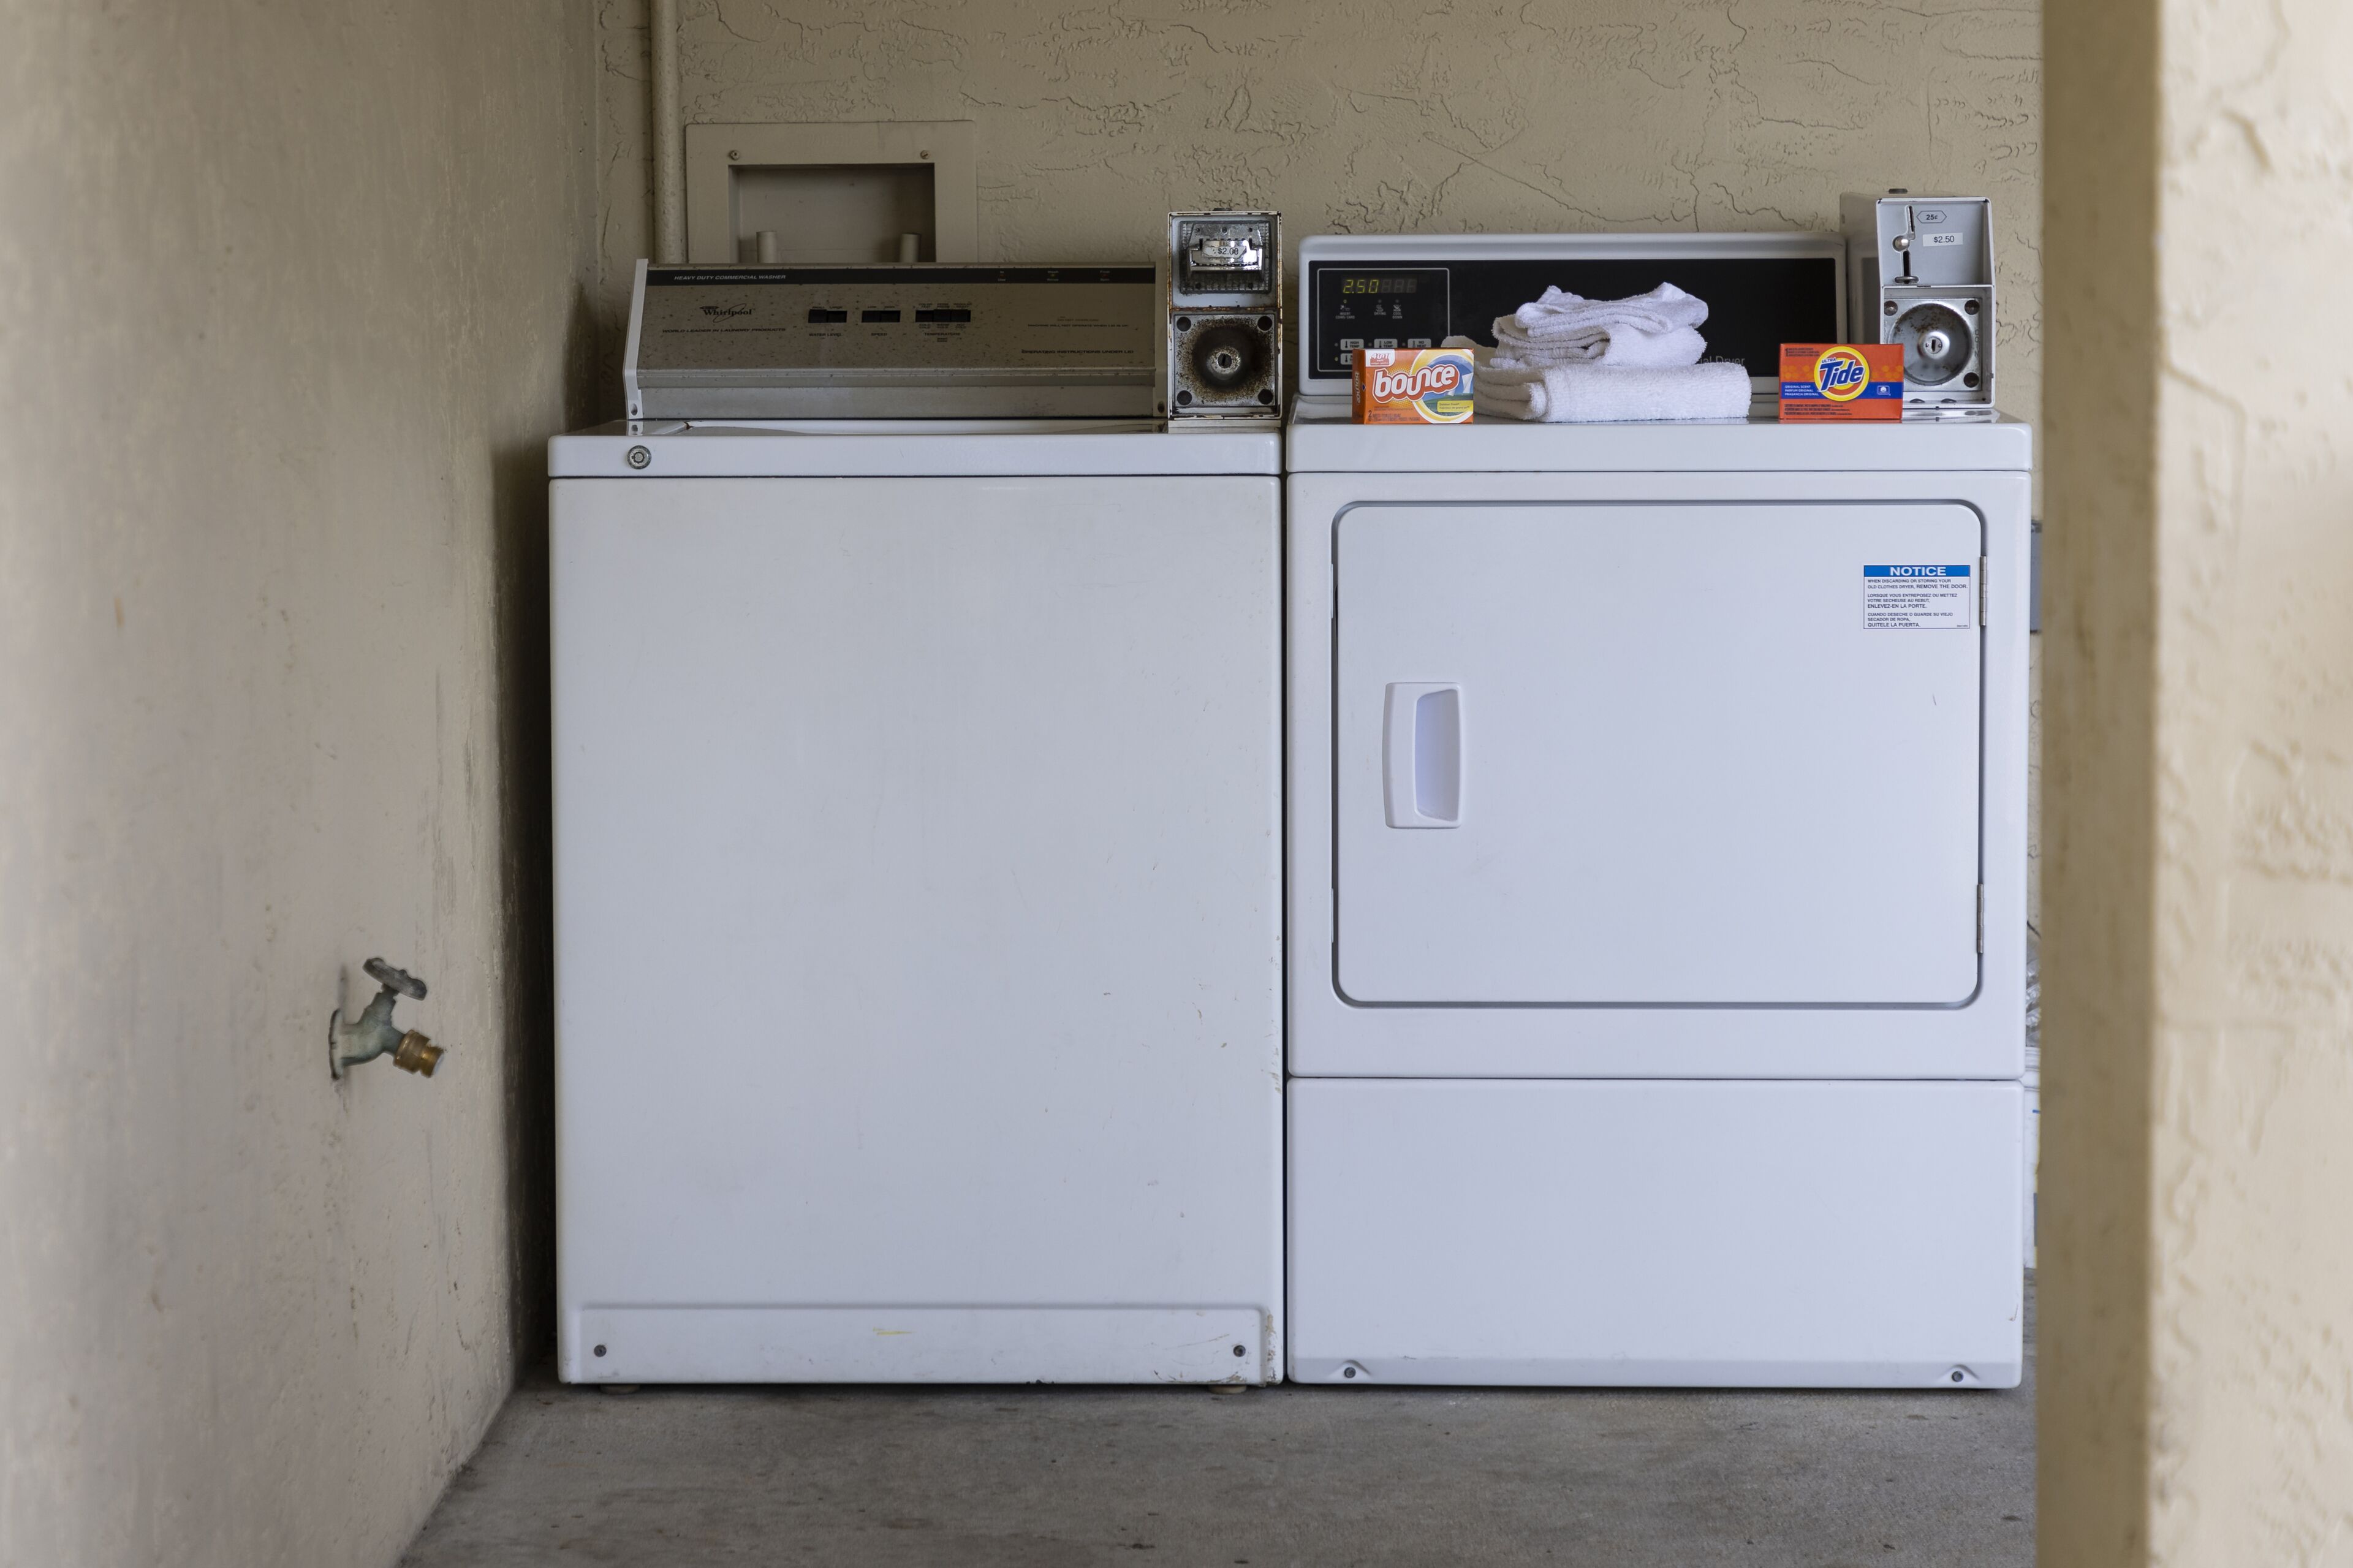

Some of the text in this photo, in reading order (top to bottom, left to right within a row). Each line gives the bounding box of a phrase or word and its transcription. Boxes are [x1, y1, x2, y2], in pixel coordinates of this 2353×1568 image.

[1343, 279, 1379, 294] 2.50
[1373, 365, 1458, 401] bounce
[1819, 360, 1865, 392] Tide
[1890, 567, 1947, 576] NOTICE
